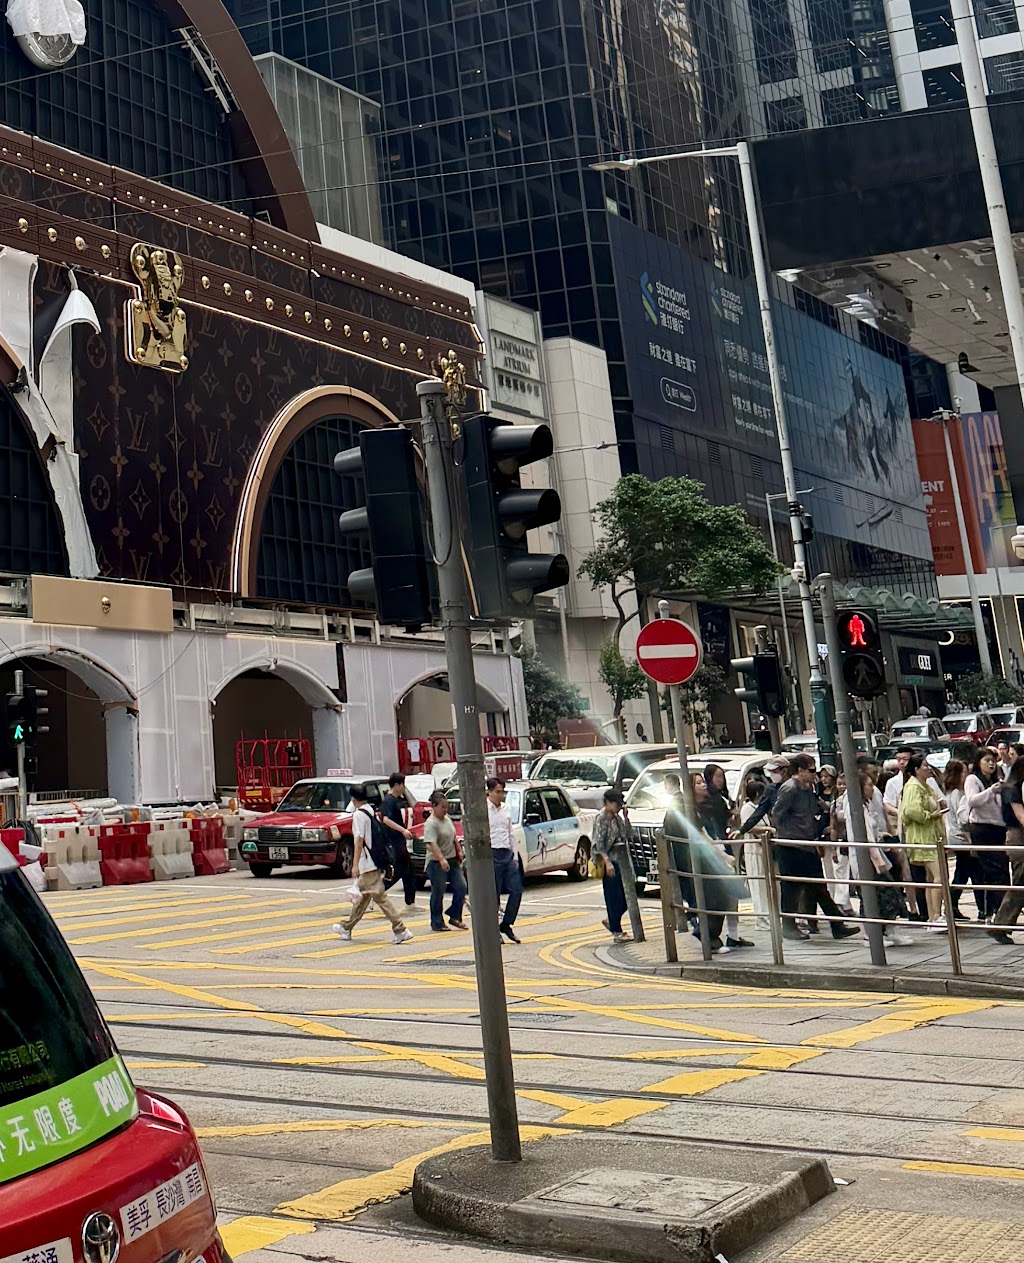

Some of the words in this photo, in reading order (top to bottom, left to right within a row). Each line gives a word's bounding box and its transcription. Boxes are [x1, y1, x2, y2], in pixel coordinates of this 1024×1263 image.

[656, 281, 687, 305] standard
[657, 296, 691, 321] chartered
[660, 311, 684, 334] 渣打銀行
[494, 337, 535, 361] LANDMARK
[504, 355, 531, 375] ATRIUM
[464, 705, 476, 714] H7
[93, 1070, 130, 1117] POAD
[126, 1199, 152, 1237] 美孚
[156, 1180, 186, 1219] 長沙灣
